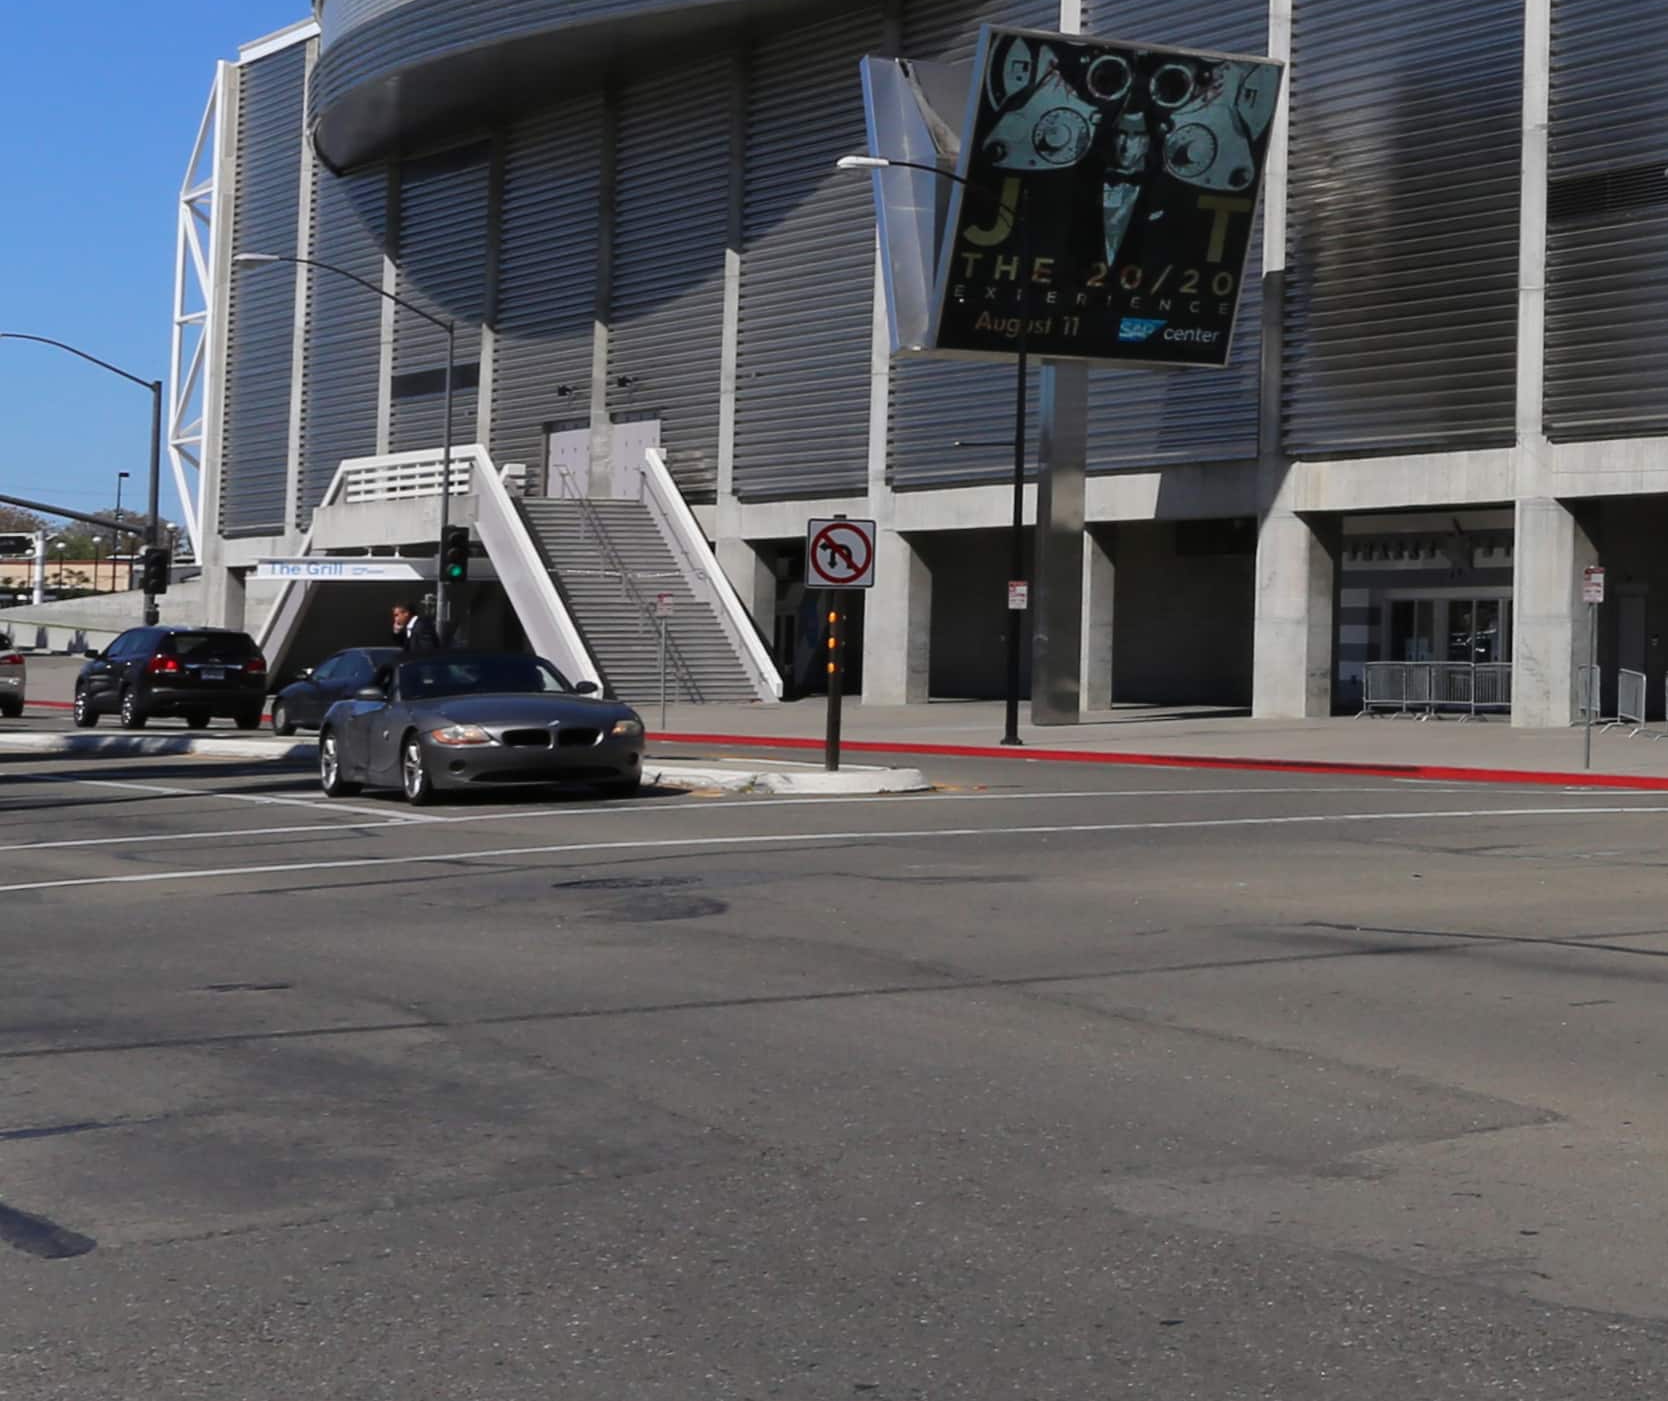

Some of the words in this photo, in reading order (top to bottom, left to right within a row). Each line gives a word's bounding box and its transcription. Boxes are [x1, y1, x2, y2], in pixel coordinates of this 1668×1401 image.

[962, 176, 1022, 247] J
[1197, 194, 1252, 264] T
[960, 251, 1056, 284] THE
[1086, 260, 1234, 297] 20/20
[1163, 327, 1220, 343] center
[270, 562, 301, 576] The
[306, 561, 344, 576] Grill
